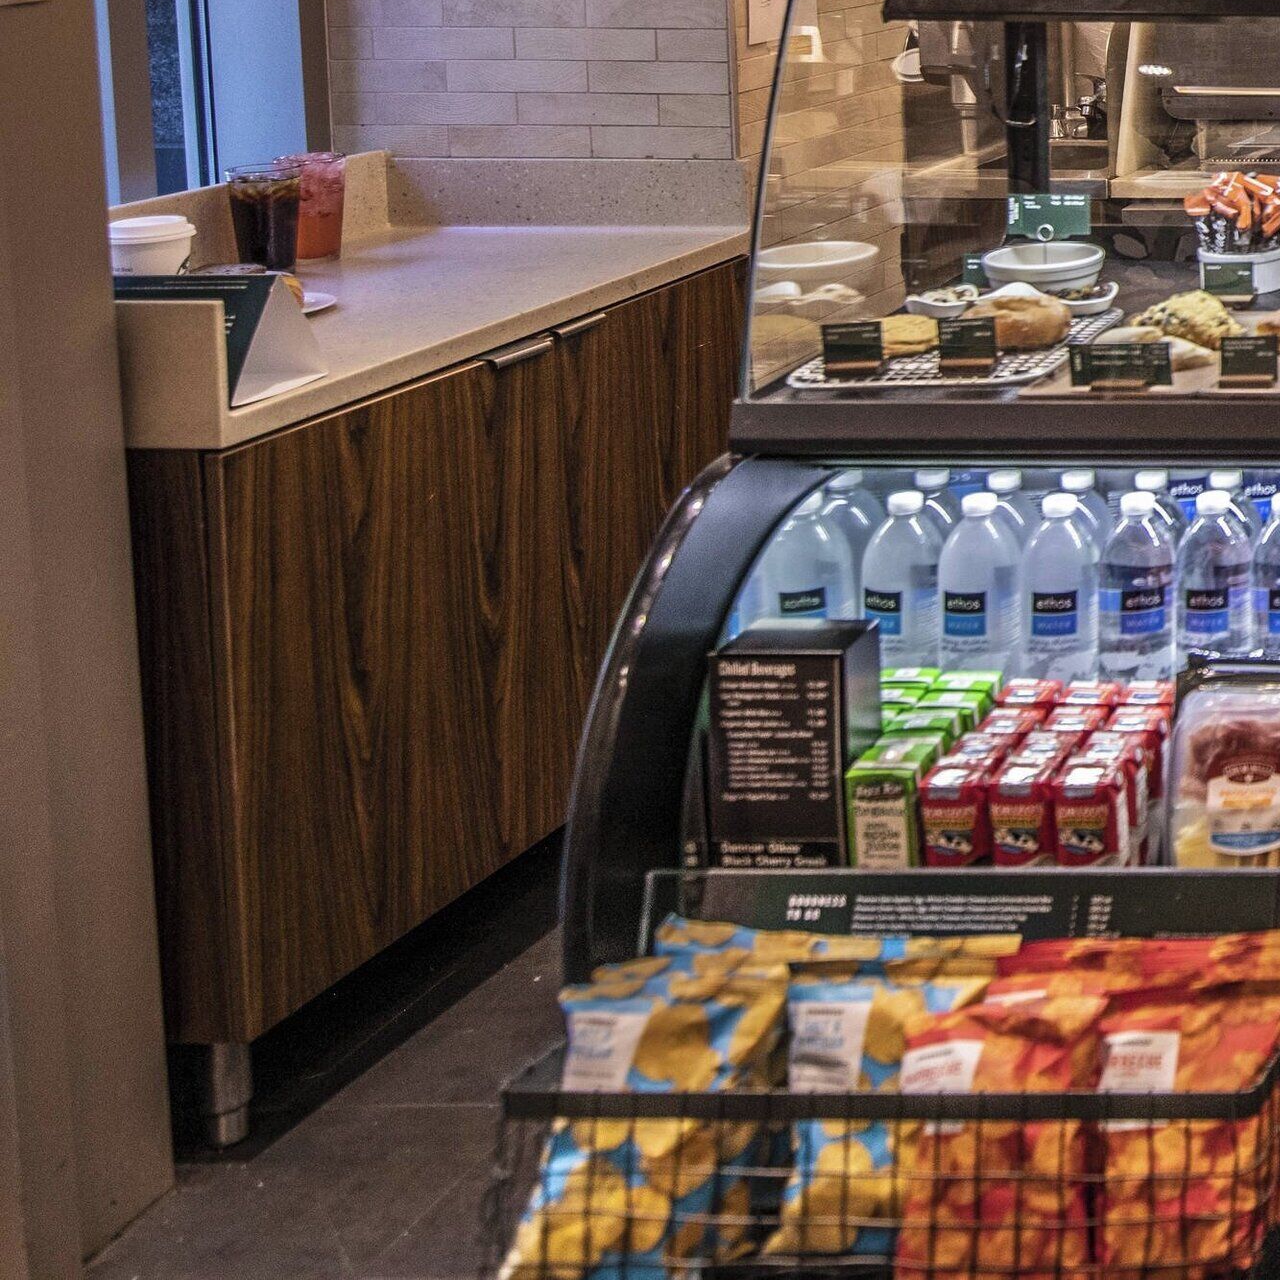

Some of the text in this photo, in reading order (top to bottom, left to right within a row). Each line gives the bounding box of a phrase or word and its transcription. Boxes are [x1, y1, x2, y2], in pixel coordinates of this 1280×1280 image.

[947, 596, 981, 611] ethos
[1036, 596, 1073, 610] ethos
[1189, 595, 1224, 608] ethos
